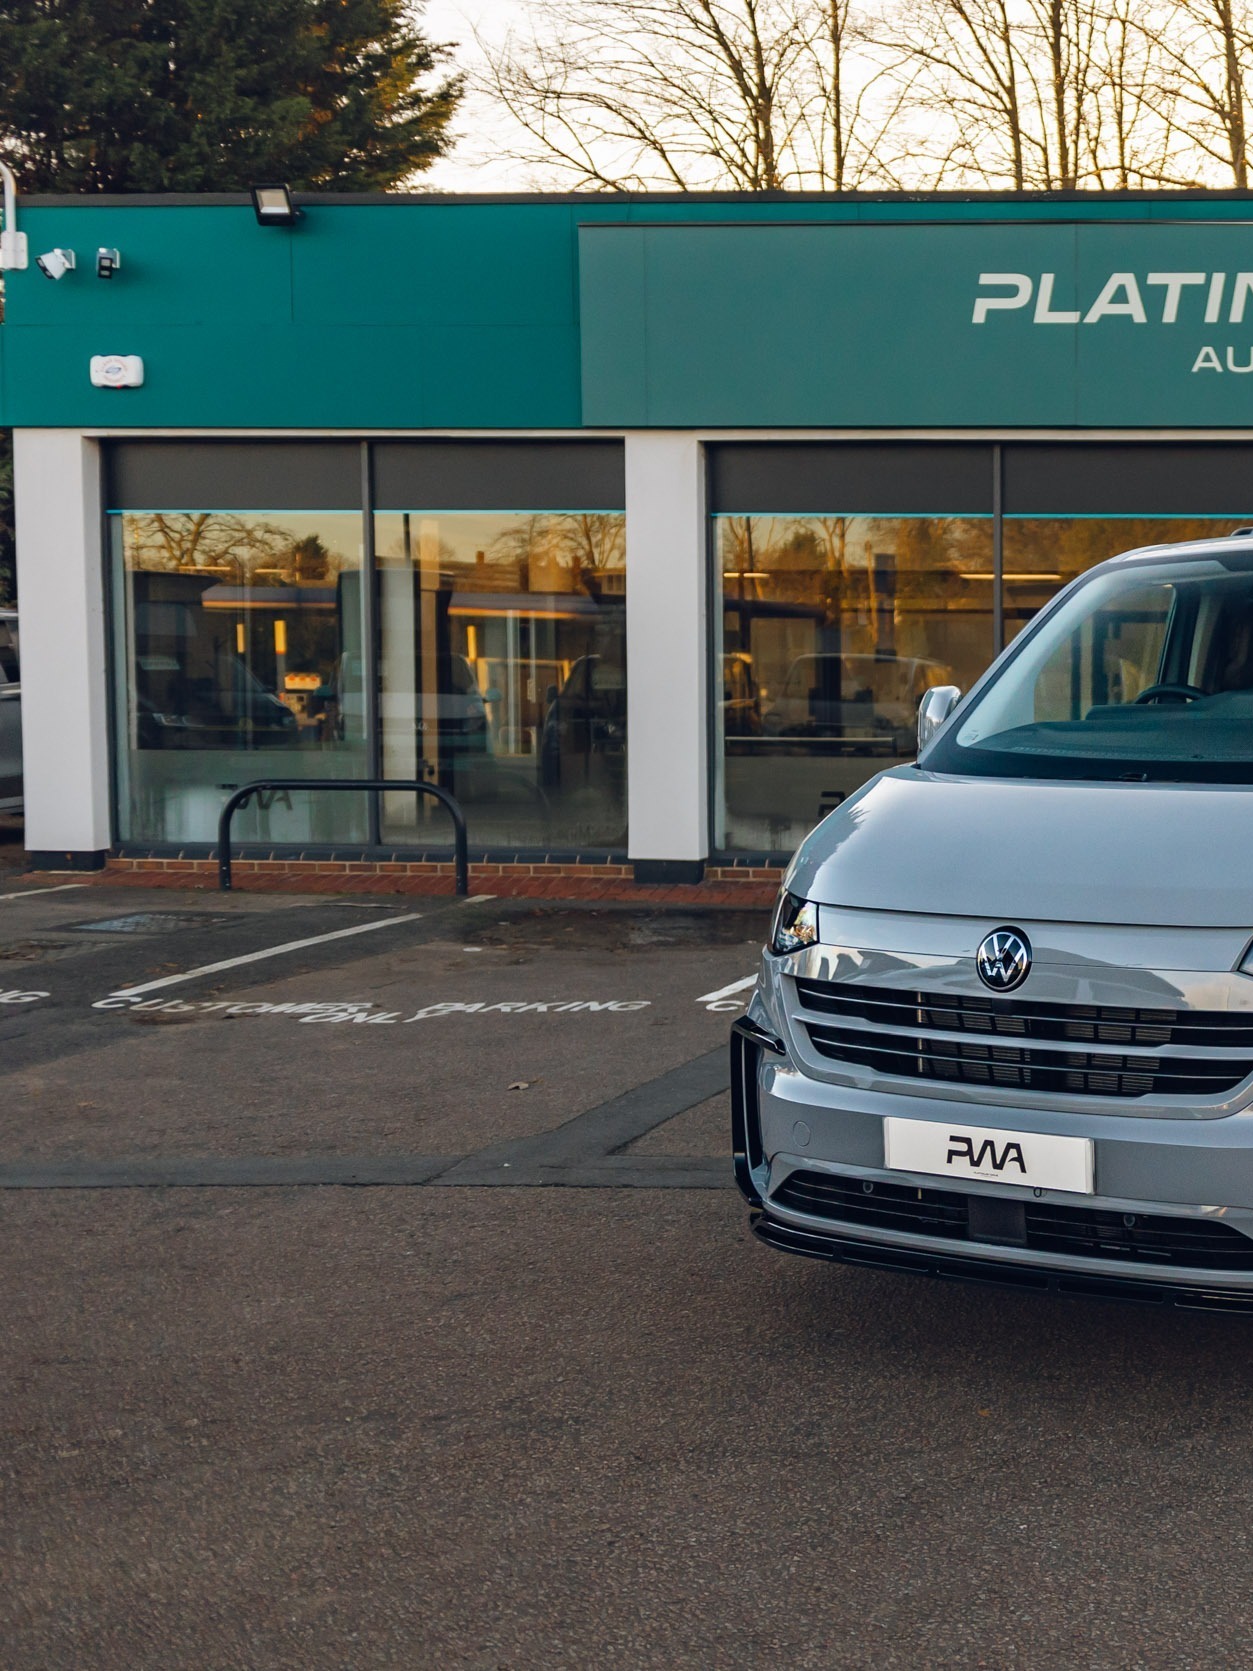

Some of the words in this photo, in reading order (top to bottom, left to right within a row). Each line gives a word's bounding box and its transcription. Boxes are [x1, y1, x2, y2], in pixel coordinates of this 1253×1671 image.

[91, 997, 372, 1014] CUSTOMER
[416, 1000, 652, 1013] PARKING
[299, 1010, 450, 1024] ONLY
[946, 1135, 1027, 1174] PWA
